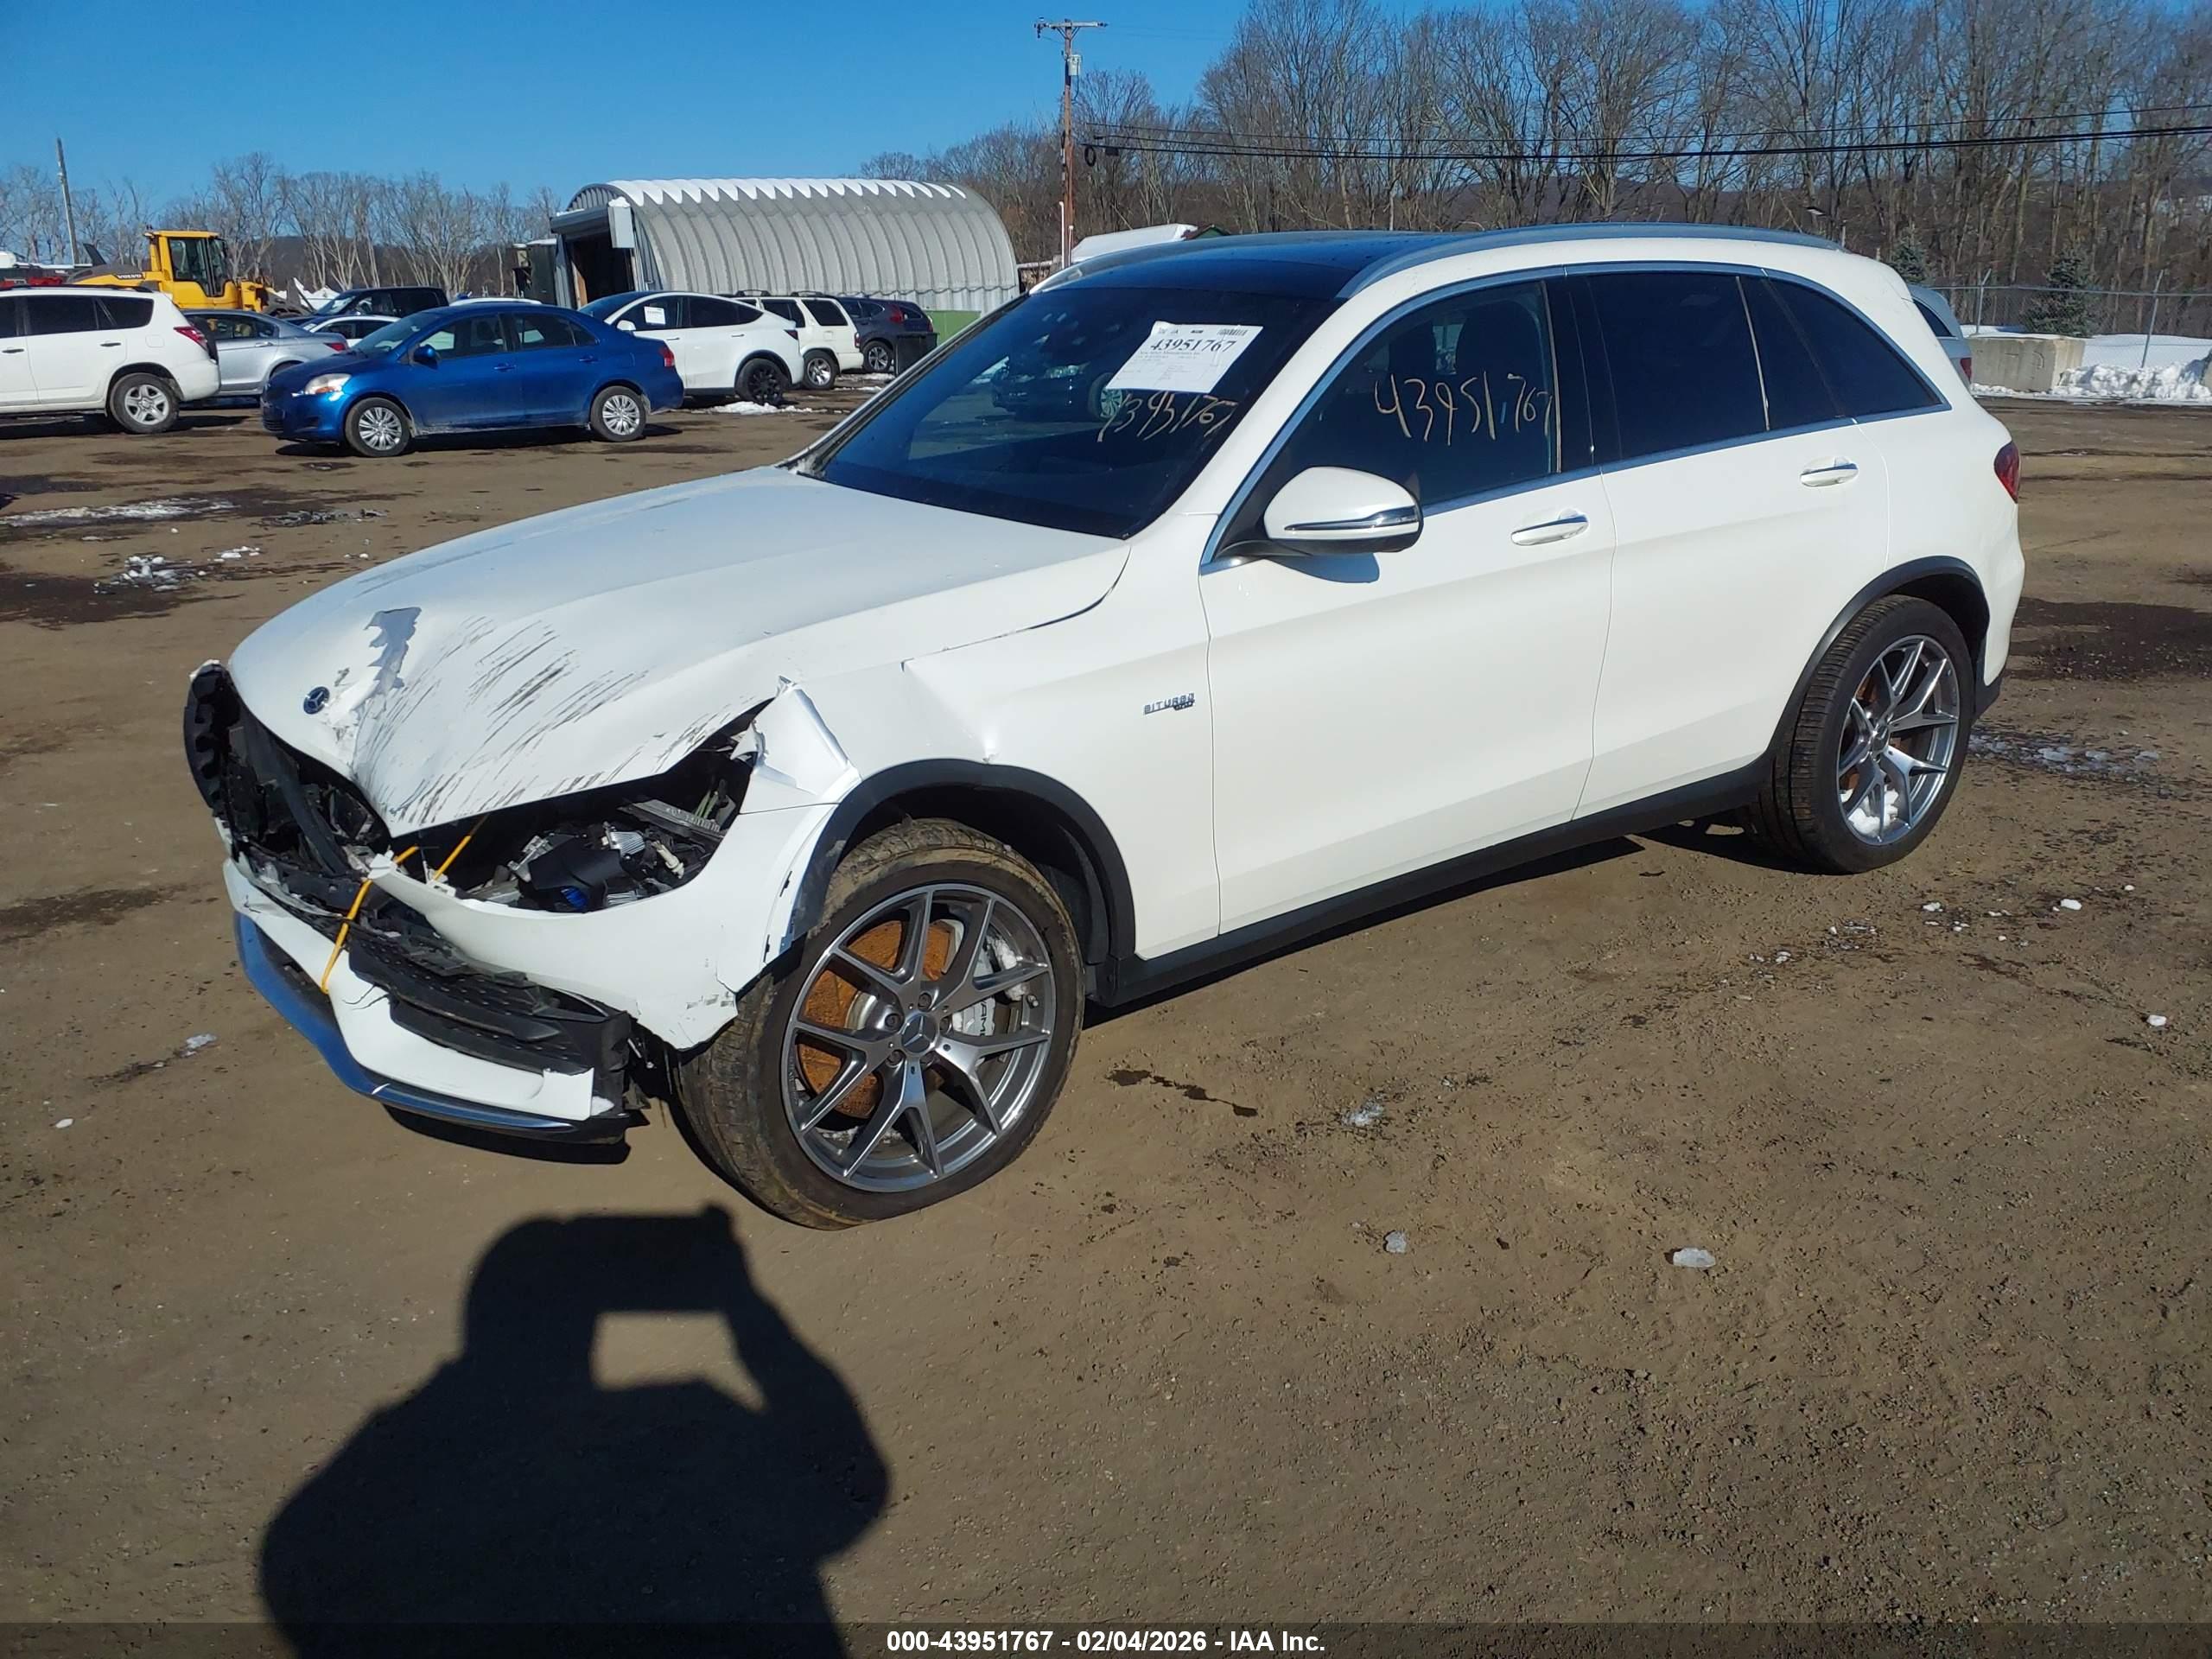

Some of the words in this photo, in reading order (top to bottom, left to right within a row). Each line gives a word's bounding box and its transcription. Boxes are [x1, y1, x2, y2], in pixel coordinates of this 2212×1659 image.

[1150, 338, 1237, 353] 43951767
[1375, 371, 1553, 446] 43951767
[1144, 692, 1194, 714] BITURBO
[979, 1002, 988, 1036] AM
